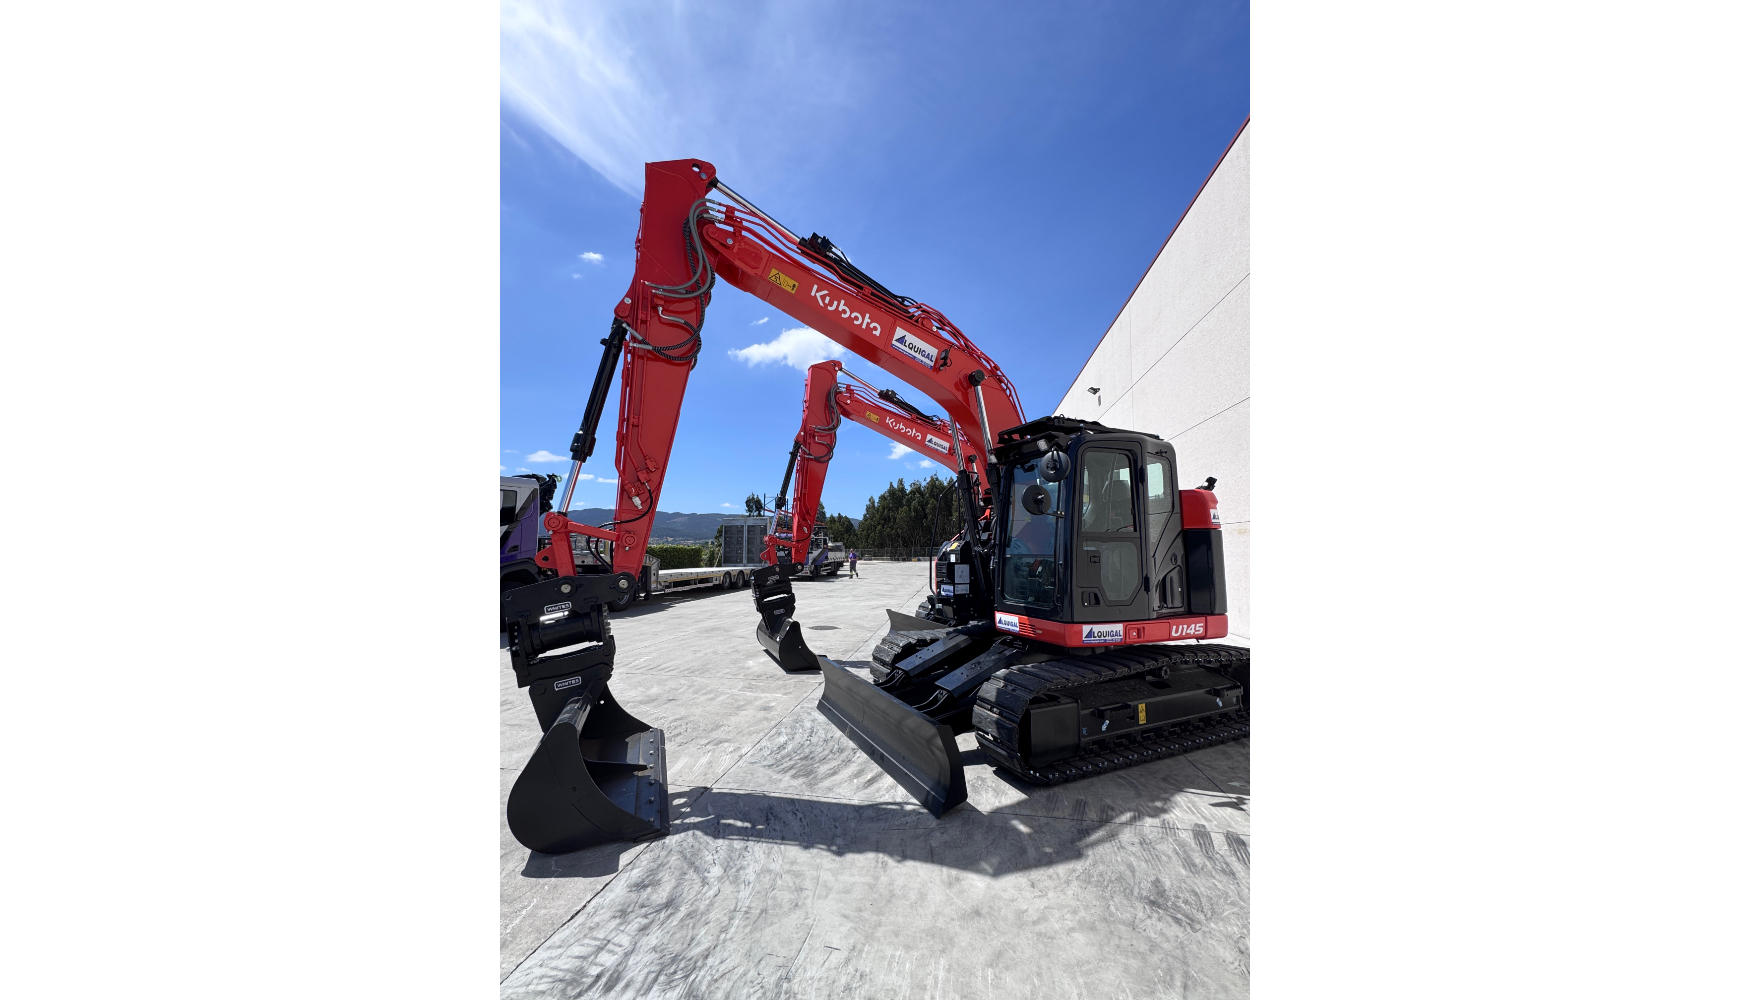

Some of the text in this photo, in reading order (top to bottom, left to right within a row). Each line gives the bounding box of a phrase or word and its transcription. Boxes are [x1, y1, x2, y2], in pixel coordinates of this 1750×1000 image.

[810, 284, 882, 337] Kubota
[886, 416, 922, 440] Kubota
[546, 603, 570, 612] WHITES
[1171, 623, 1204, 637] U145
[557, 678, 580, 688] WHITES
